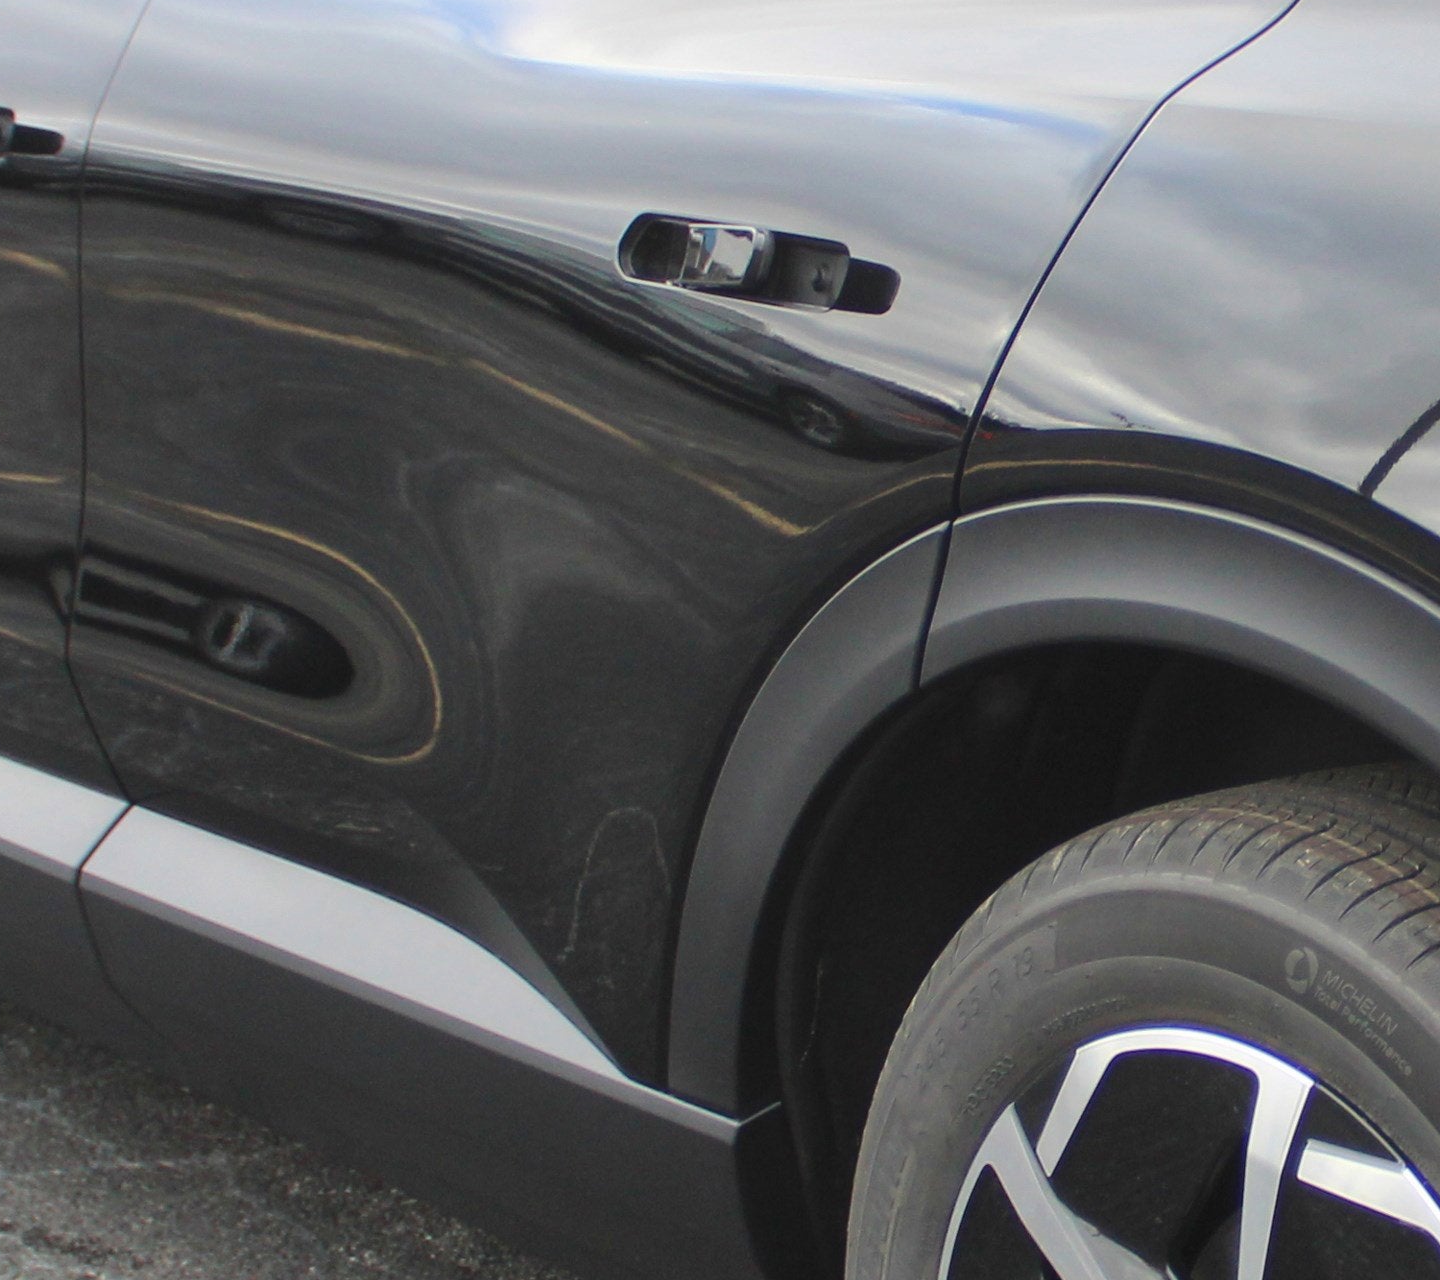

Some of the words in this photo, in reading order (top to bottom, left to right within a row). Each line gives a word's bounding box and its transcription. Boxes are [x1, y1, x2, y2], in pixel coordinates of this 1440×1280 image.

[1313, 985, 1343, 1013] Total
[1341, 1006, 1413, 1077] Performance
[1321, 970, 1399, 1036] MICHELIN
